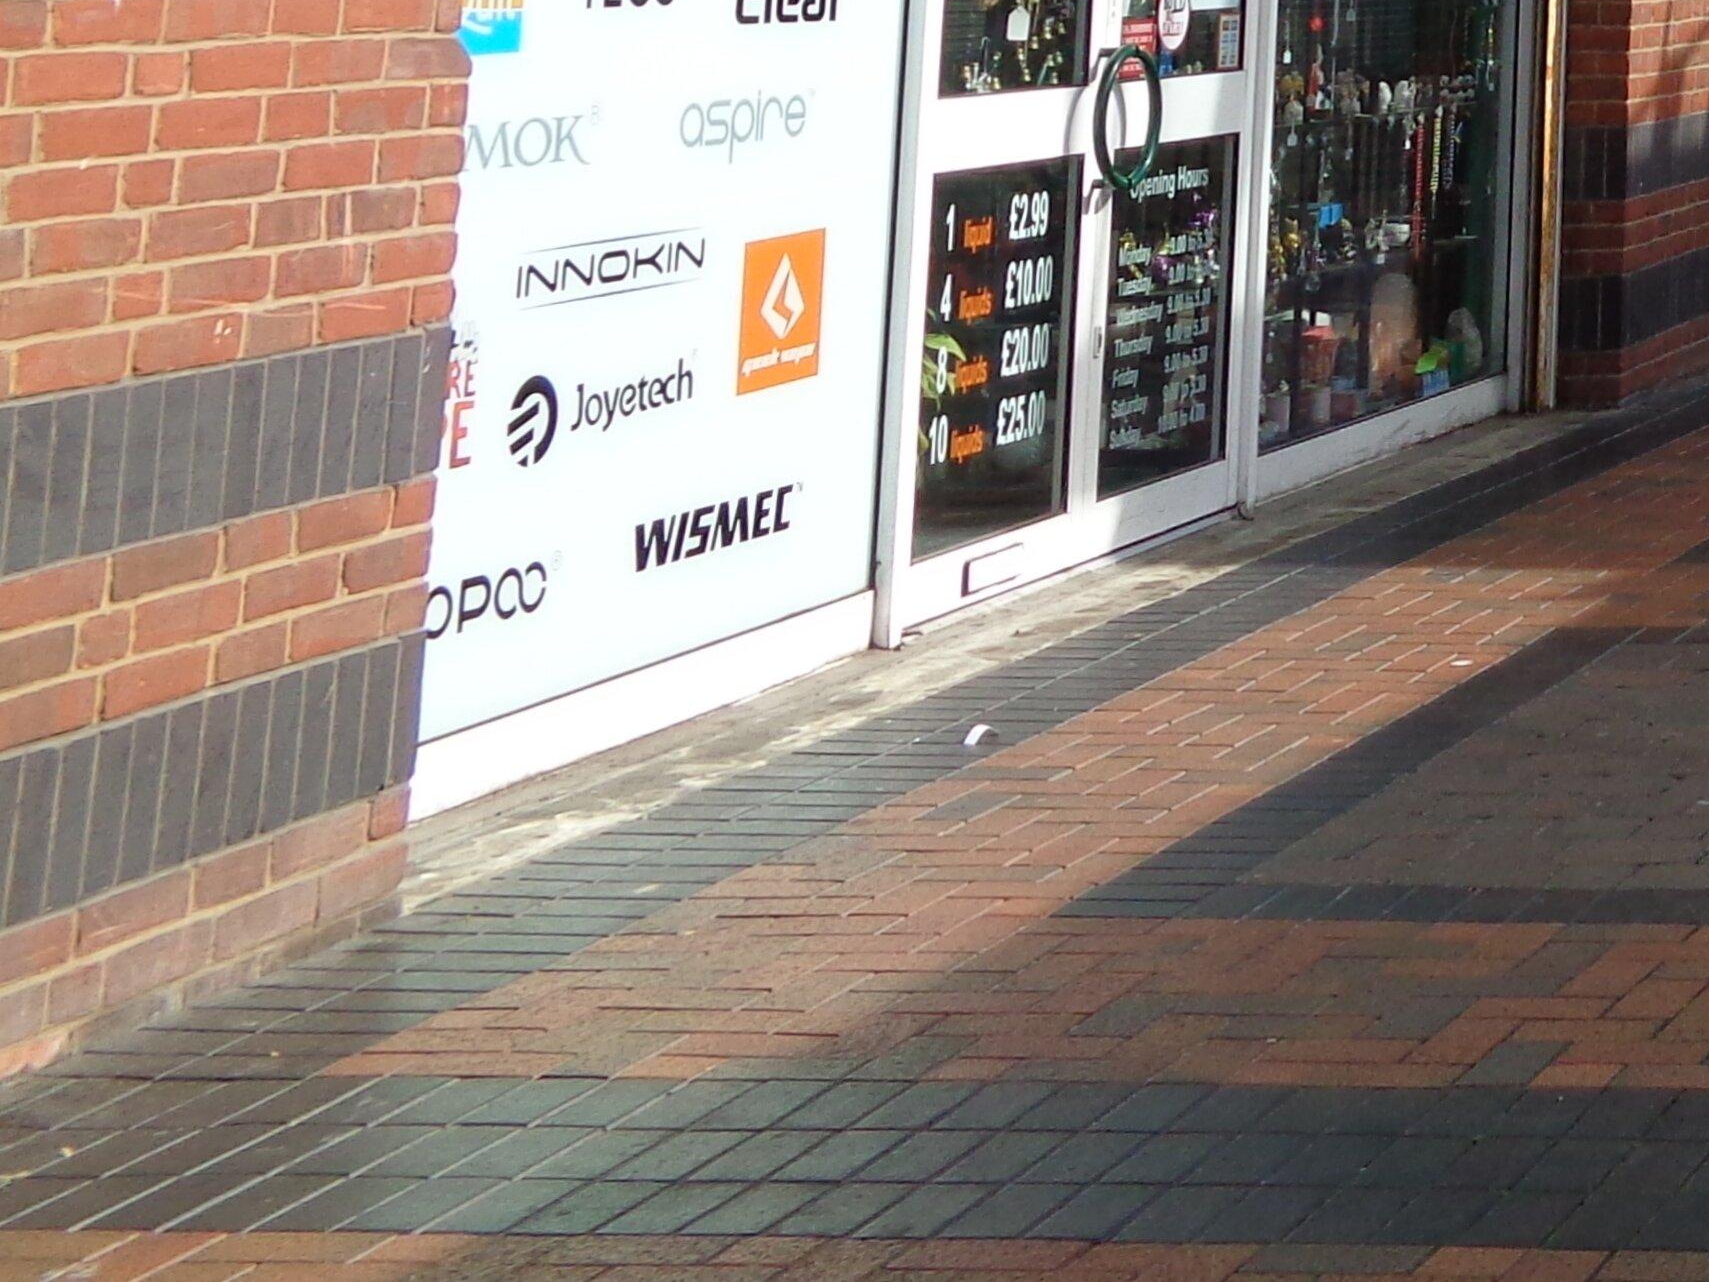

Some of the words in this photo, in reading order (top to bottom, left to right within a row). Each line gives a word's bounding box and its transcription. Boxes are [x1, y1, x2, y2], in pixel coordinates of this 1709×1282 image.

[678, 88, 808, 164] aspire
[1176, 164, 1210, 192] Hours
[946, 203, 956, 253] 1
[1009, 189, 1050, 241] £2.99
[515, 237, 707, 300] INNOKIN
[940, 273, 952, 323] 4
[1005, 255, 1054, 312] £10.00
[936, 346, 948, 395] 8
[1000, 322, 1050, 380] £20.00
[569, 358, 696, 434] Joyetech
[928, 414, 949, 467] 10
[996, 388, 1047, 448] £25.00
[634, 483, 794, 573] WISMEC
